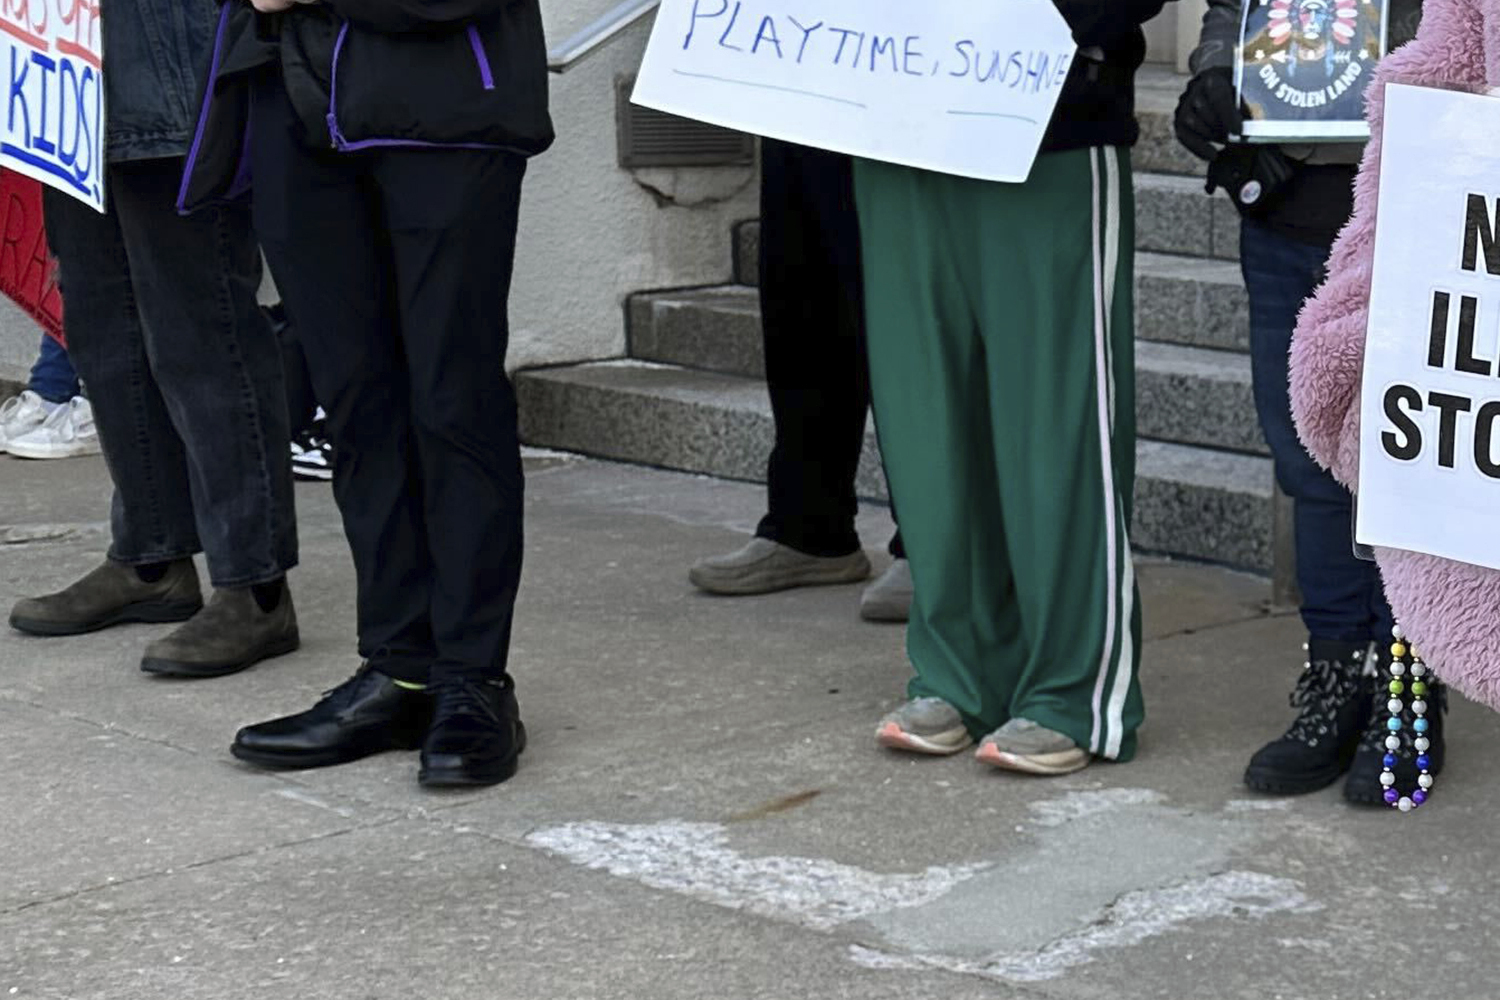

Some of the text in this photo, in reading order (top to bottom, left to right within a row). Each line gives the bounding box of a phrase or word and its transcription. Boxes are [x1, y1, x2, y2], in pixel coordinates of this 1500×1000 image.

[8, 44, 101, 204] KIDS!
[1259, 61, 1362, 108] ON STOLEN LAND
